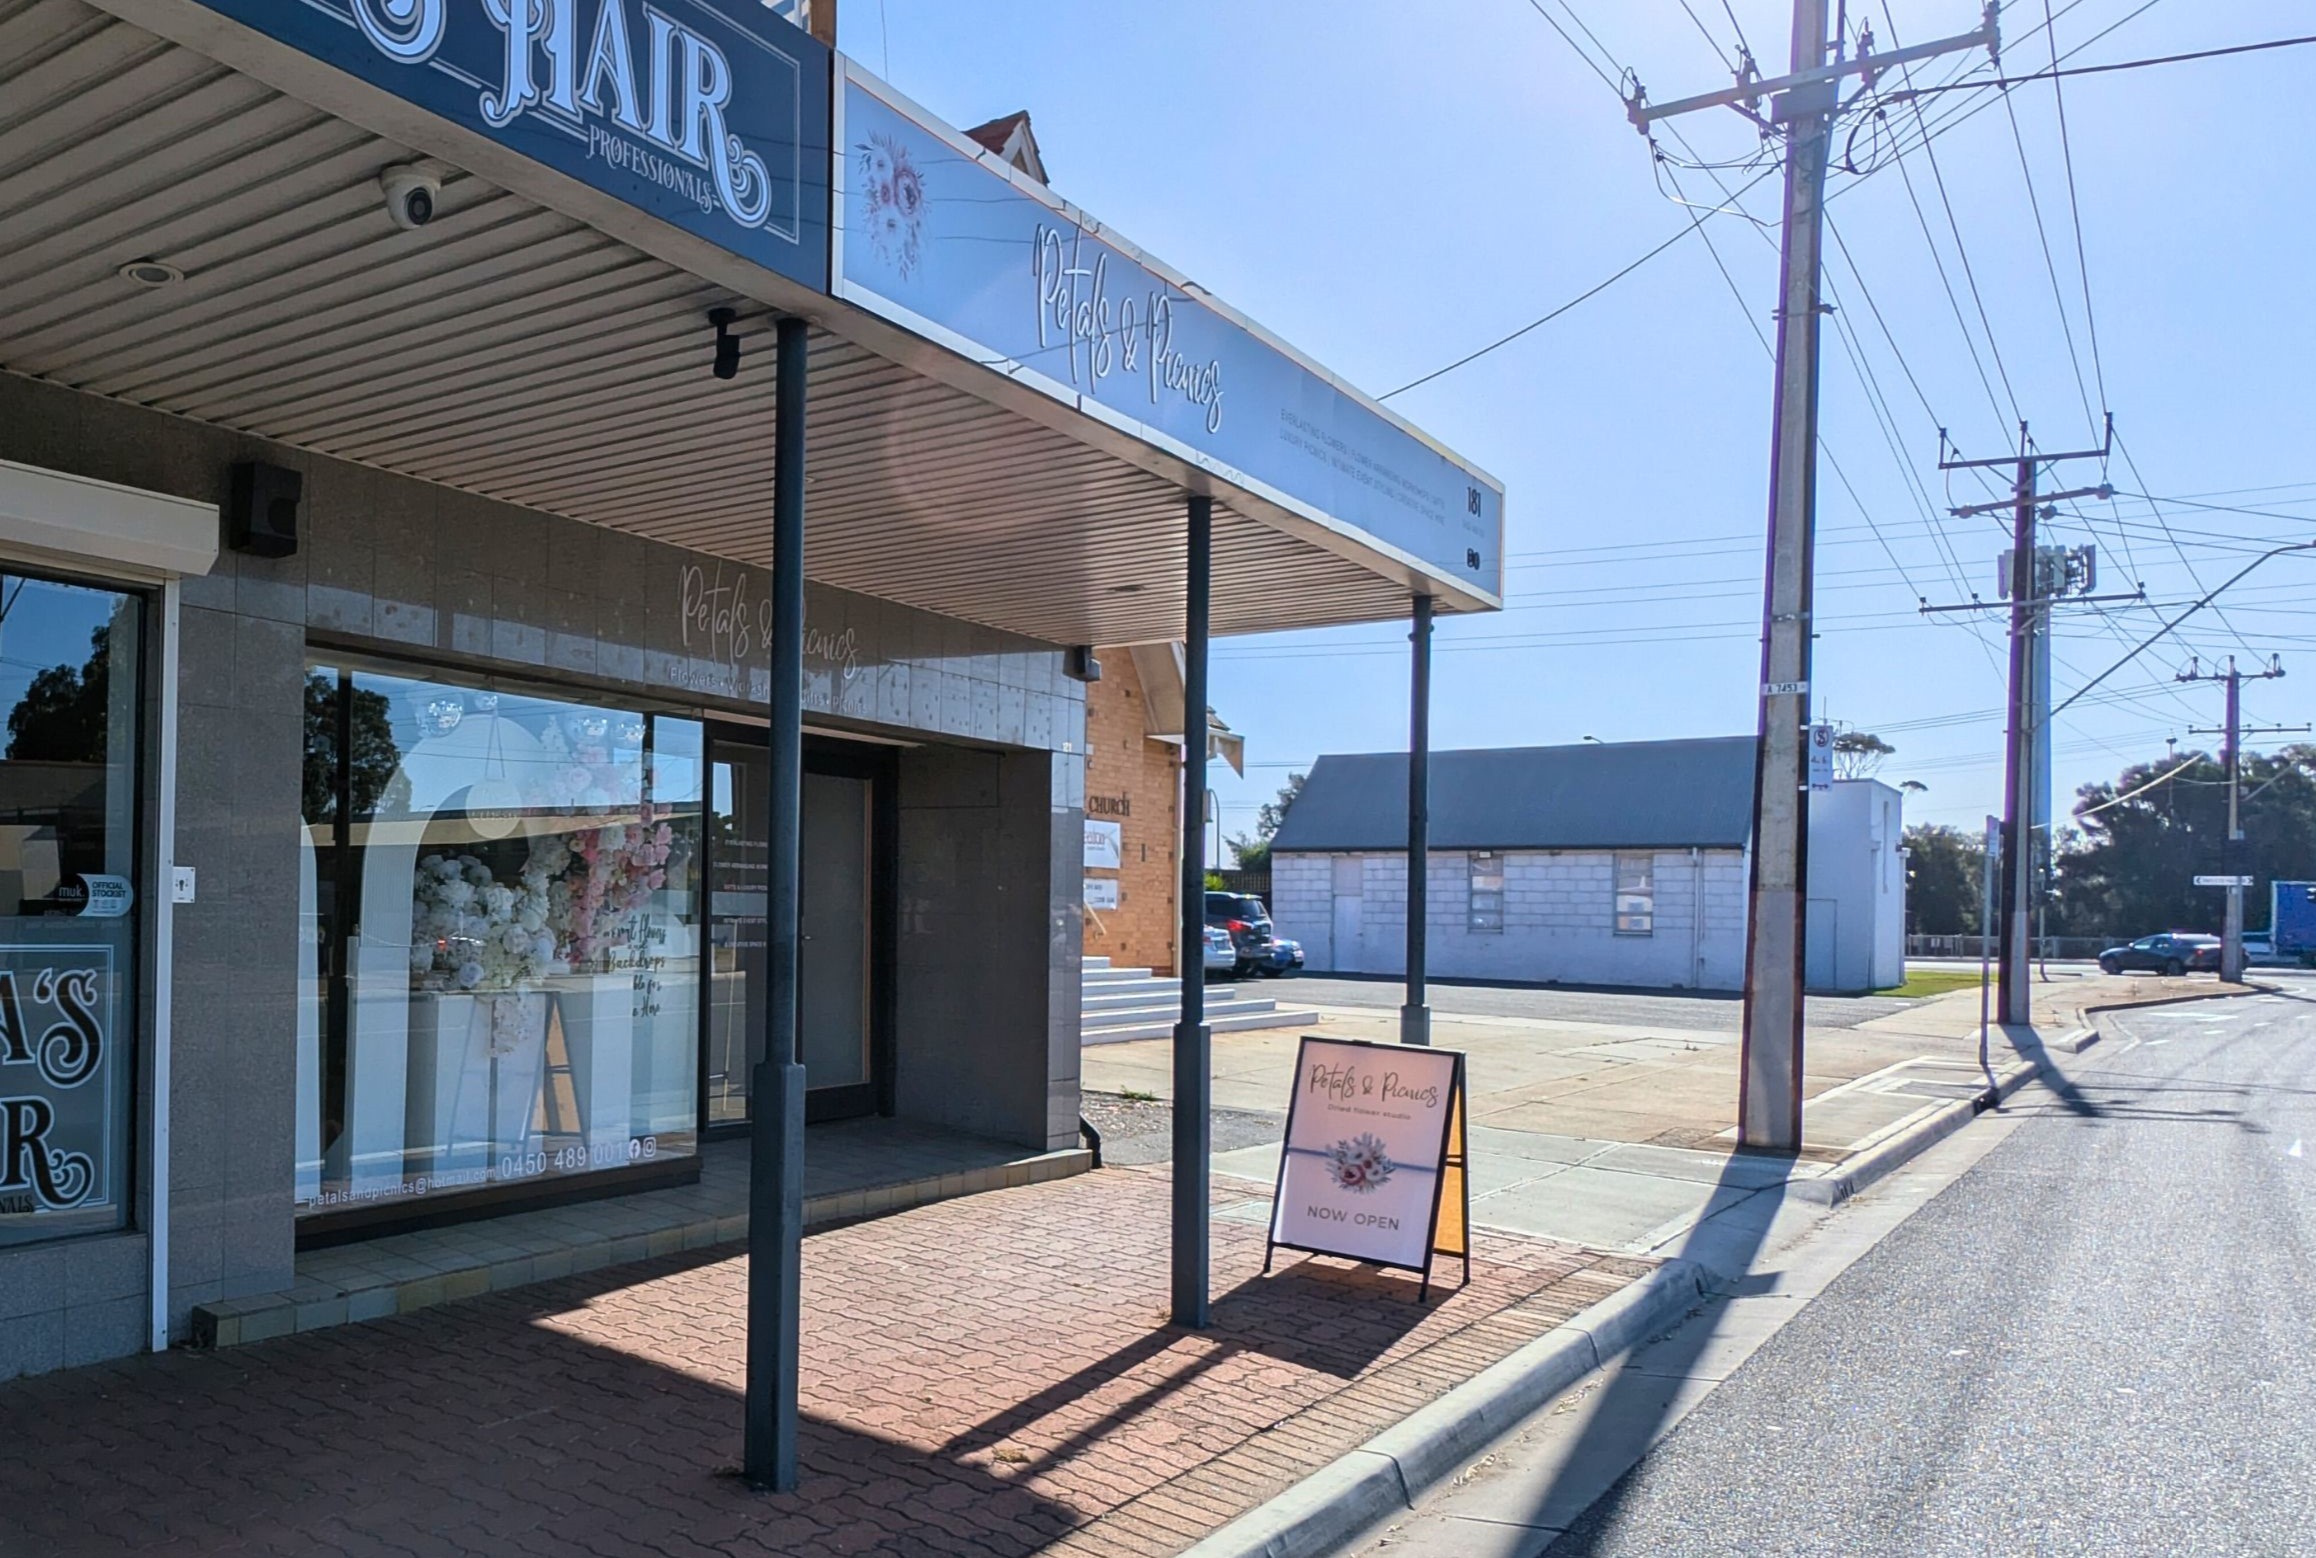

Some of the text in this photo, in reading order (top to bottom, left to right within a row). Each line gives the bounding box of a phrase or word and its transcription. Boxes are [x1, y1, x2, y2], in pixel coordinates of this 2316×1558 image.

[481, 0, 772, 229] HAIR
[586, 125, 714, 214] PROFESSIONALS
[1033, 223, 1224, 434] Petals & Picnics
[679, 560, 752, 672] Petals
[92, 881, 124, 890] OFFICIAL
[1309, 1062, 1439, 1108] Petals & Picnics
[502, 1152, 547, 1177] 0450
[554, 1146, 587, 1168] 489
[1307, 1205, 1400, 1231] NOW OPEN
